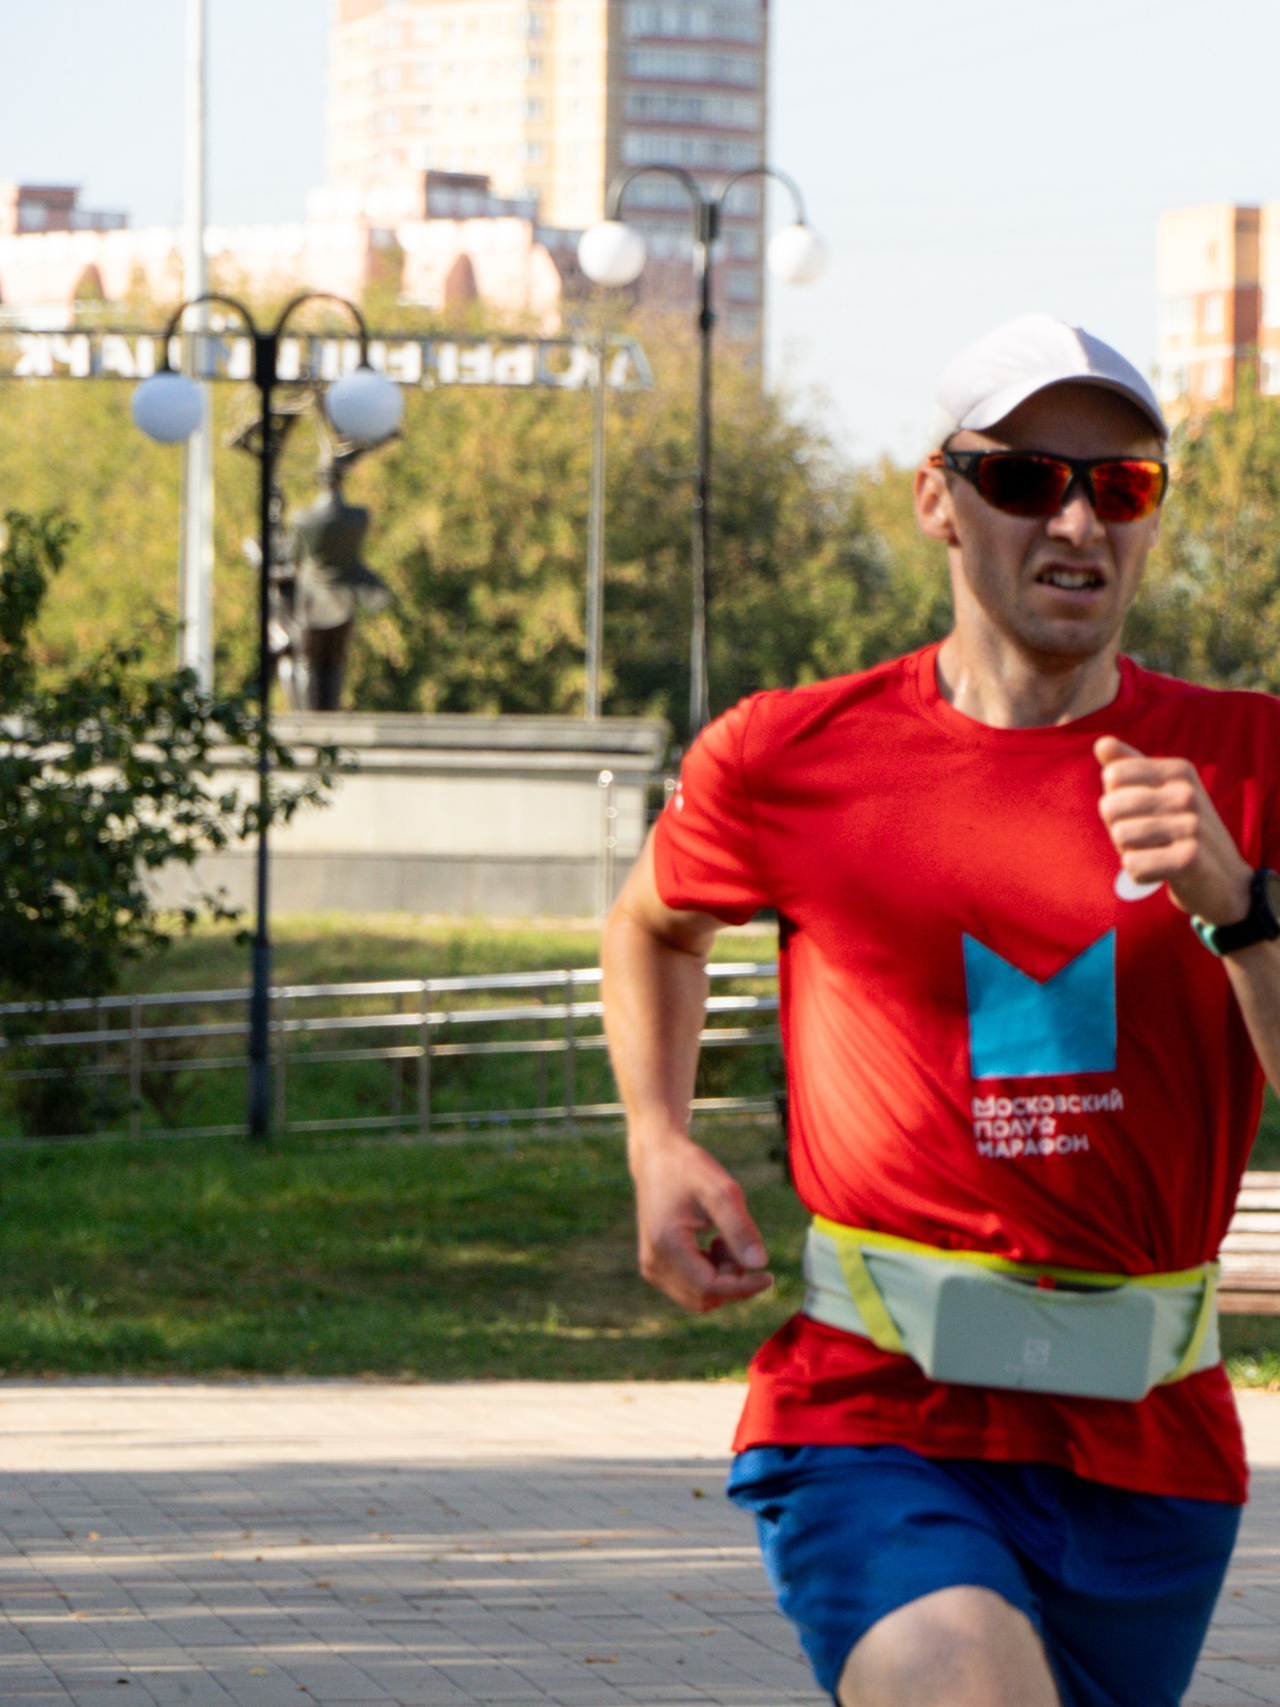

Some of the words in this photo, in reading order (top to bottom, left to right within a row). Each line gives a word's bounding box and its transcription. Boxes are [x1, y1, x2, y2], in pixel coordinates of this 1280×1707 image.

[971, 1087, 1124, 1118] МОСКОВСКИЙ
[974, 1117, 1036, 1138] ПОЛУ
[976, 1134, 1089, 1158] МАРАФОН
